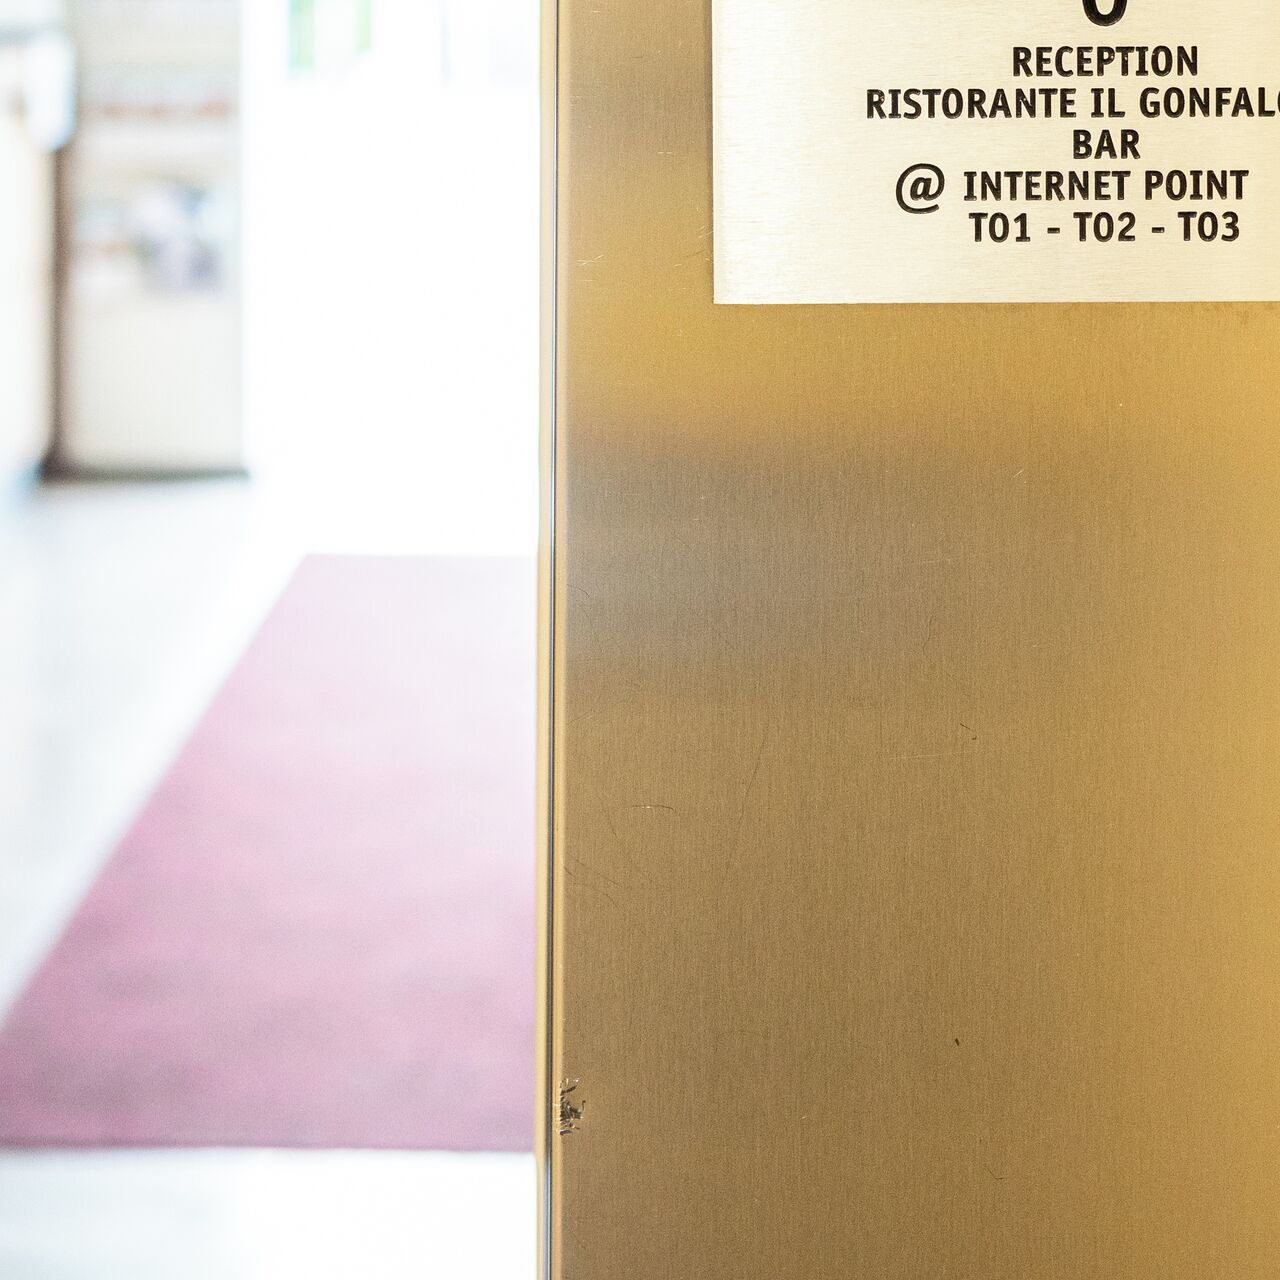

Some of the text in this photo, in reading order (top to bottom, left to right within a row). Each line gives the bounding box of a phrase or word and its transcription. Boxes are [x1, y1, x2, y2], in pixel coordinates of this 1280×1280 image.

[1012, 45, 1198, 78] RECEPTION
[866, 87, 1077, 120] RISTORANTE
[1090, 87, 1126, 118] IL
[1072, 128, 1141, 160] BAR
[895, 162, 1250, 215] @ INTERNET POINT
